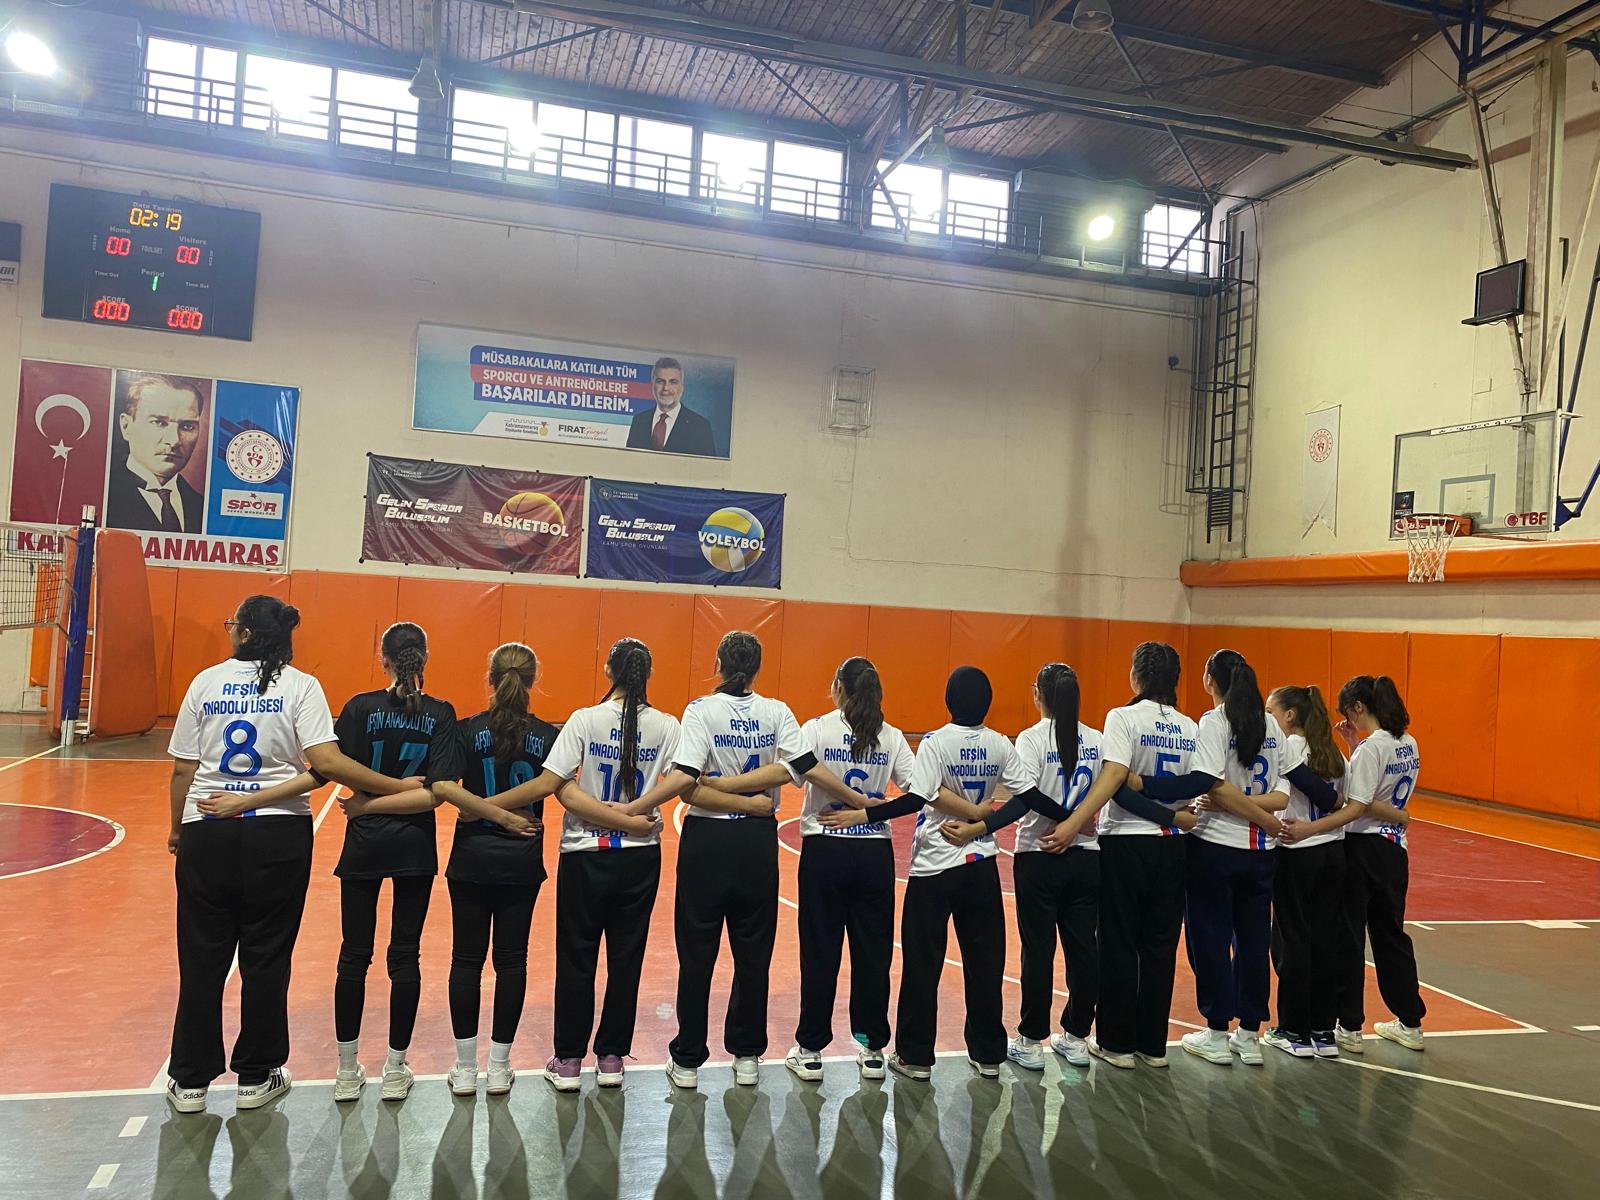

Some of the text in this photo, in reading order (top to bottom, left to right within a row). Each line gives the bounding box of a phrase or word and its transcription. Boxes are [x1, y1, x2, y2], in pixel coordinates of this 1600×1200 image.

[110, 225, 131, 235] Home
[106, 236, 131, 256] 00
[179, 235, 207, 246] Visitors
[176, 245, 200, 265] 00
[95, 269, 107, 277] Time
[141, 268, 165, 278] Period
[185, 281, 199, 289] Time
[102, 295, 126, 304] SCORE
[175, 304, 199, 312] SCORE
[94, 300, 130, 321] 000
[167, 309, 203, 330] 000
[481, 351, 638, 379] MÜSABAKALARA KATILAN TÜM
[482, 369, 629, 395] SPORCU VE ANTRENÖRLERE
[481, 383, 635, 414] BAŞARILAR DİLERİM.
[558, 424, 585, 434] FIRAT
[227, 499, 277, 513] SPOR
[482, 511, 569, 538] BASKETBOL
[1519, 511, 1548, 526] TBF
[697, 530, 766, 552] VOLEYBOL
[250, 695, 284, 714] LİSESİ
[729, 718, 760, 734] AFŞİN
[1155, 721, 1182, 735] AFŞİN
[219, 719, 263, 777] 8
[713, 734, 752, 748] ANADOLU
[1140, 734, 1197, 752] ANADOLU LİSESİ
[960, 745, 987, 762] AFŞİN
[1395, 743, 1414, 759] AFŞİN
[1245, 754, 1269, 796] 3
[962, 781, 987, 805] 7
[1056, 765, 1093, 812] 12
